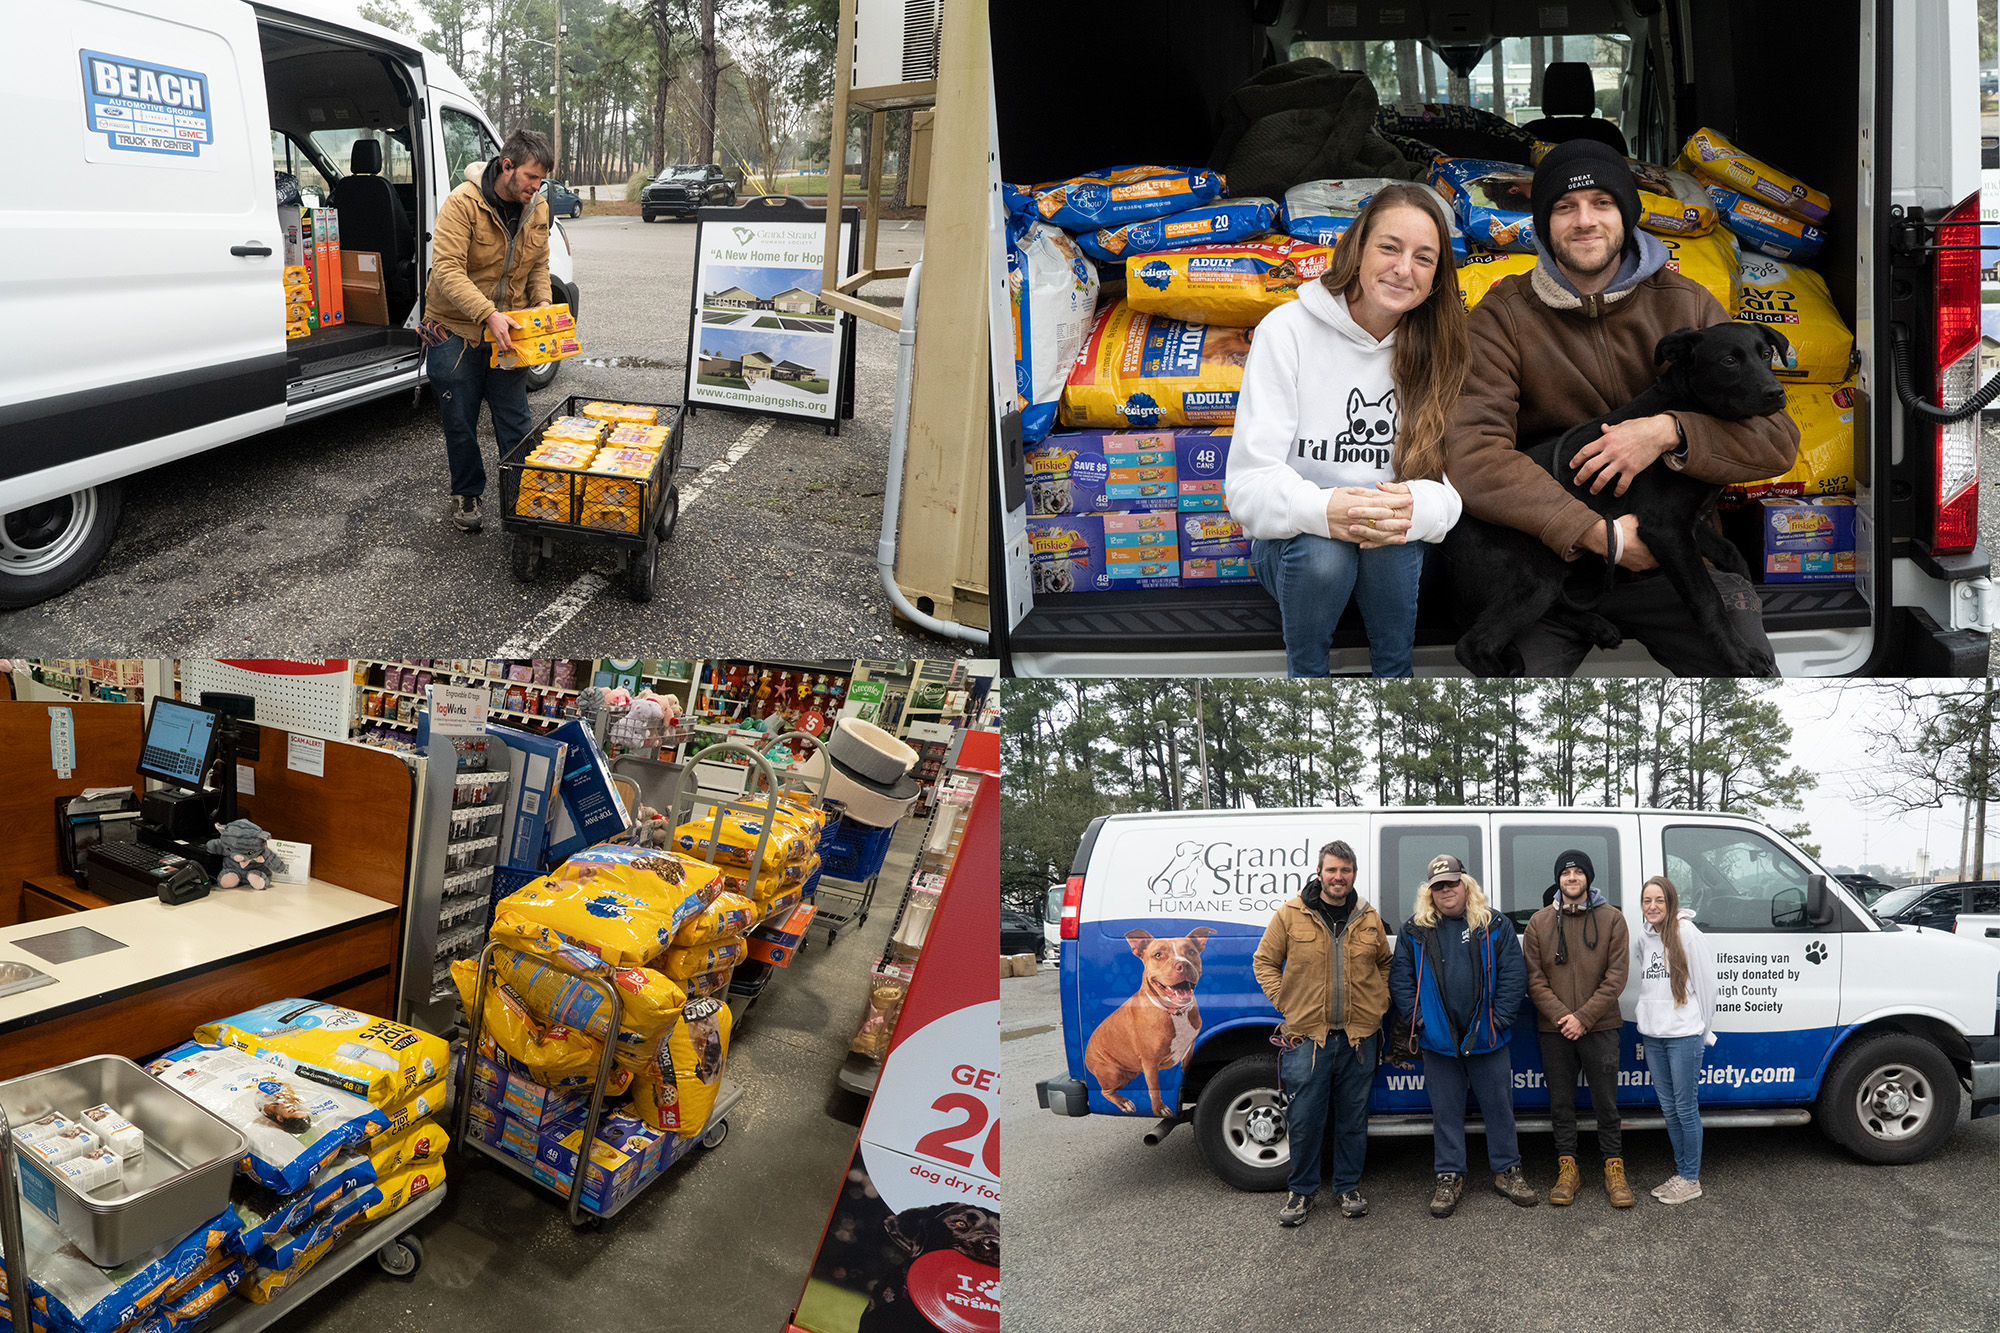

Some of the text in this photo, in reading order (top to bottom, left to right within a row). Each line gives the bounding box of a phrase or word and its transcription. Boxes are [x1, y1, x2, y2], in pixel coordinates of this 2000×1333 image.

[93, 60, 203, 110] BEACH
[109, 98, 193, 116] AUTOMOTIVE GROUP
[176, 118, 205, 127] VOLVO
[179, 130, 203, 139] GMC
[118, 135, 193, 150] TRUCK RV CENTER
[1118, 175, 1206, 193] COMPLETE 15
[1568, 180, 1595, 190] DEALER
[1569, 174, 1592, 183] TREAT
[1686, 209, 1696, 217] 14
[1167, 214, 1229, 231] COMPLETE 20
[1742, 203, 1819, 237] COMPLETE 15
[757, 229, 817, 240] Grand Strand
[725, 250, 748, 261] New
[750, 250, 780, 262] Home
[784, 251, 799, 263] for
[802, 252, 824, 265] Hop
[1190, 258, 1234, 267] ADULT
[1297, 256, 1326, 267] 44LB
[1133, 268, 1178, 278] Pedigree
[1298, 264, 1324, 273] VALUE
[1302, 270, 1320, 278] SIZE
[1740, 261, 1779, 277] glad
[1740, 287, 1796, 301] CAT
[1740, 297, 1798, 312] TID
[1737, 312, 1782, 322] PURIN
[1134, 314, 1148, 364] OASTED CHICKEN
[1155, 337, 1164, 347] NO
[1177, 321, 1204, 370] DULT
[1122, 347, 1134, 372] FLAVOR
[1152, 358, 1160, 371] NO
[696, 387, 827, 414] www.campaigngshs.org
[1185, 393, 1233, 404] ADULT
[1115, 404, 1168, 417] Pedigree
[1196, 450, 1216, 463] 48
[1297, 438, 1390, 470] I'd boop
[1035, 460, 1068, 471] Friskies
[1073, 461, 1108, 472] SAVE $5
[1819, 476, 1849, 488] CATS
[1747, 487, 1798, 499] PERFORANCE
[1820, 485, 1848, 495] TIDY
[1096, 495, 1109, 503] 48
[1183, 499, 1189, 507] 12
[1205, 528, 1230, 536] Friskies
[1792, 521, 1816, 530] Friskies
[1035, 540, 1068, 551] Friskies
[1097, 574, 1109, 582] 48
[445, 689, 467, 699] Engravable
[851, 684, 882, 697] Greenies
[436, 702, 467, 717] TagWorks
[804, 715, 817, 731] $5
[290, 735, 322, 748] SCAM ALERT!
[1204, 838, 1310, 872] Grand
[1212, 865, 1318, 895] Stran
[1149, 898, 1233, 912] HUMANE
[1716, 952, 1790, 965] lifesaving van
[628, 971, 645, 983] 30
[1717, 969, 1800, 982] usly donated by
[1741, 985, 1778, 997] County
[1716, 1001, 1783, 1013] mane Society
[377, 1024, 412, 1045] TIDY
[660, 1046, 671, 1067] DOG
[343, 1082, 353, 1090] 48
[392, 1114, 409, 1128] TIDY
[666, 1110, 676, 1126] 40
[391, 1121, 410, 1136] CATS
[910, 1165, 940, 1184] dog
[944, 1176, 974, 1199] dry
[227, 1270, 240, 1285] 15
[956, 1274, 974, 1293] I
[946, 1292, 1000, 1314] PETSMA
